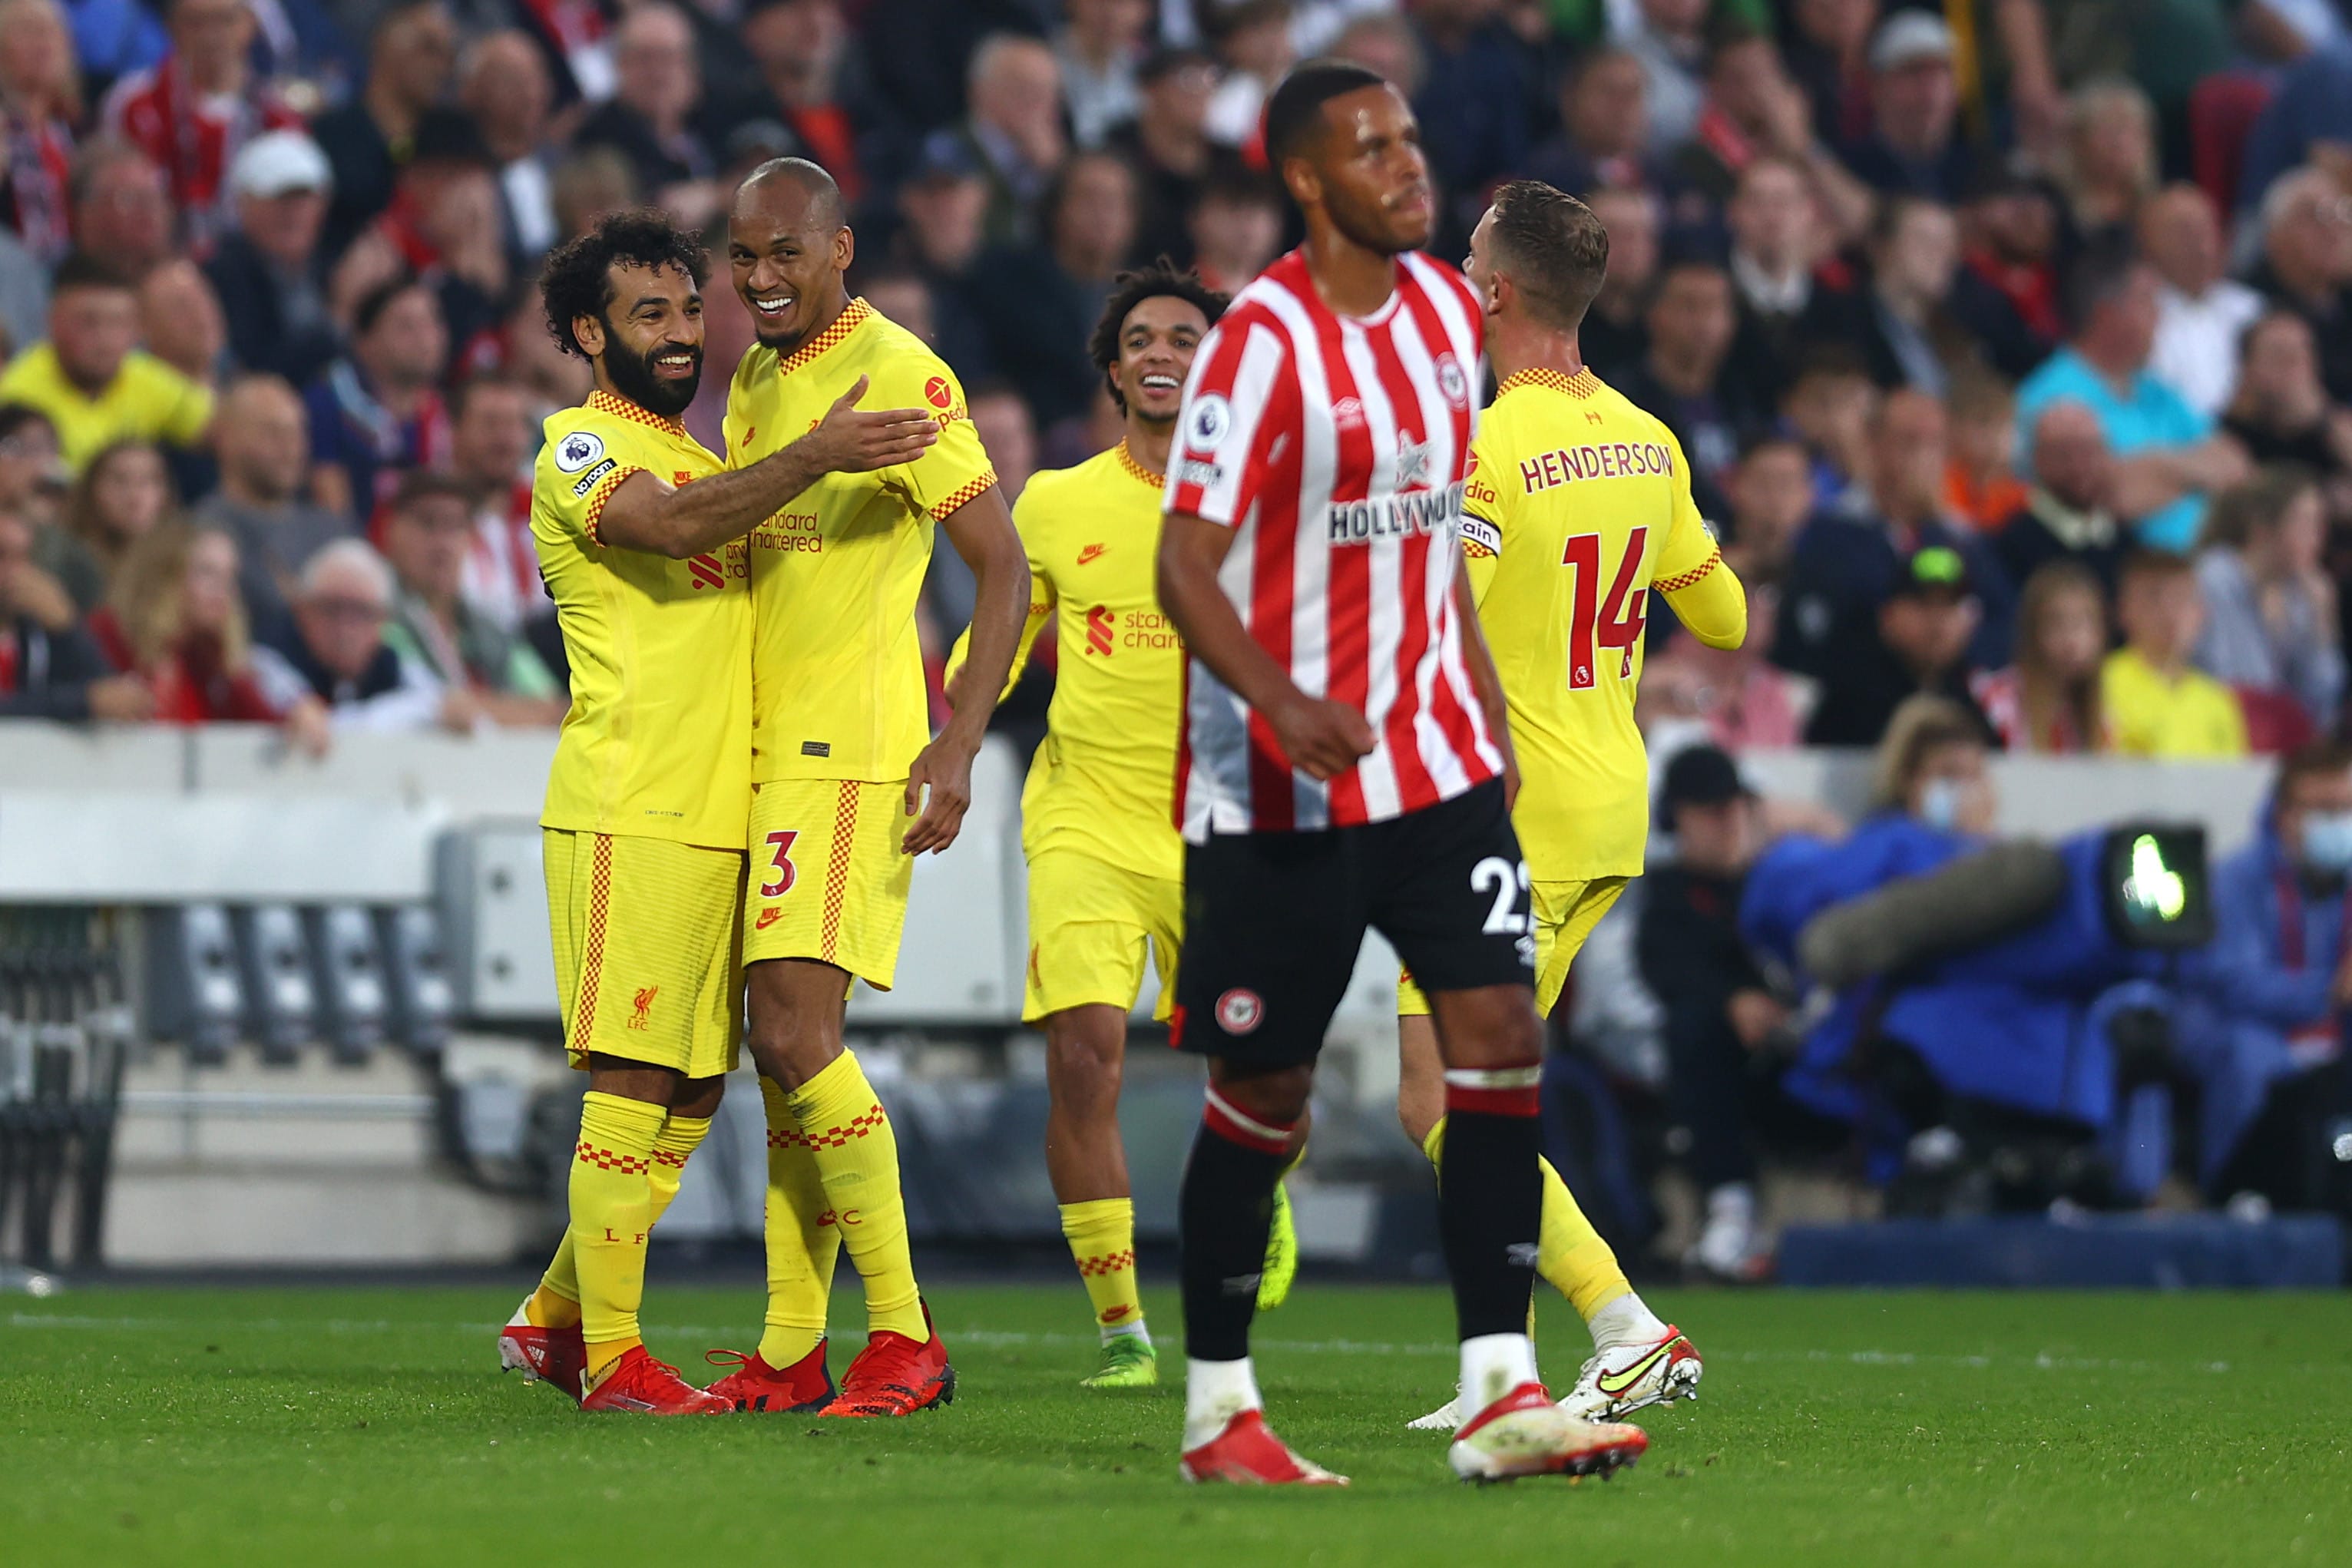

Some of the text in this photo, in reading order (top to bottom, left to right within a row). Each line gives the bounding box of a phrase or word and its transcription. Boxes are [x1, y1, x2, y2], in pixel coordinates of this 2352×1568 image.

[573, 461, 613, 498] No room
[1520, 443, 1673, 495] HENDERSON
[750, 528, 822, 554] hartered
[1459, 521, 1492, 544] ain
[1561, 524, 1649, 690] 14
[759, 829, 799, 899] 3
[1470, 855, 1533, 936] 2
[627, 1019, 649, 1031] LFC
